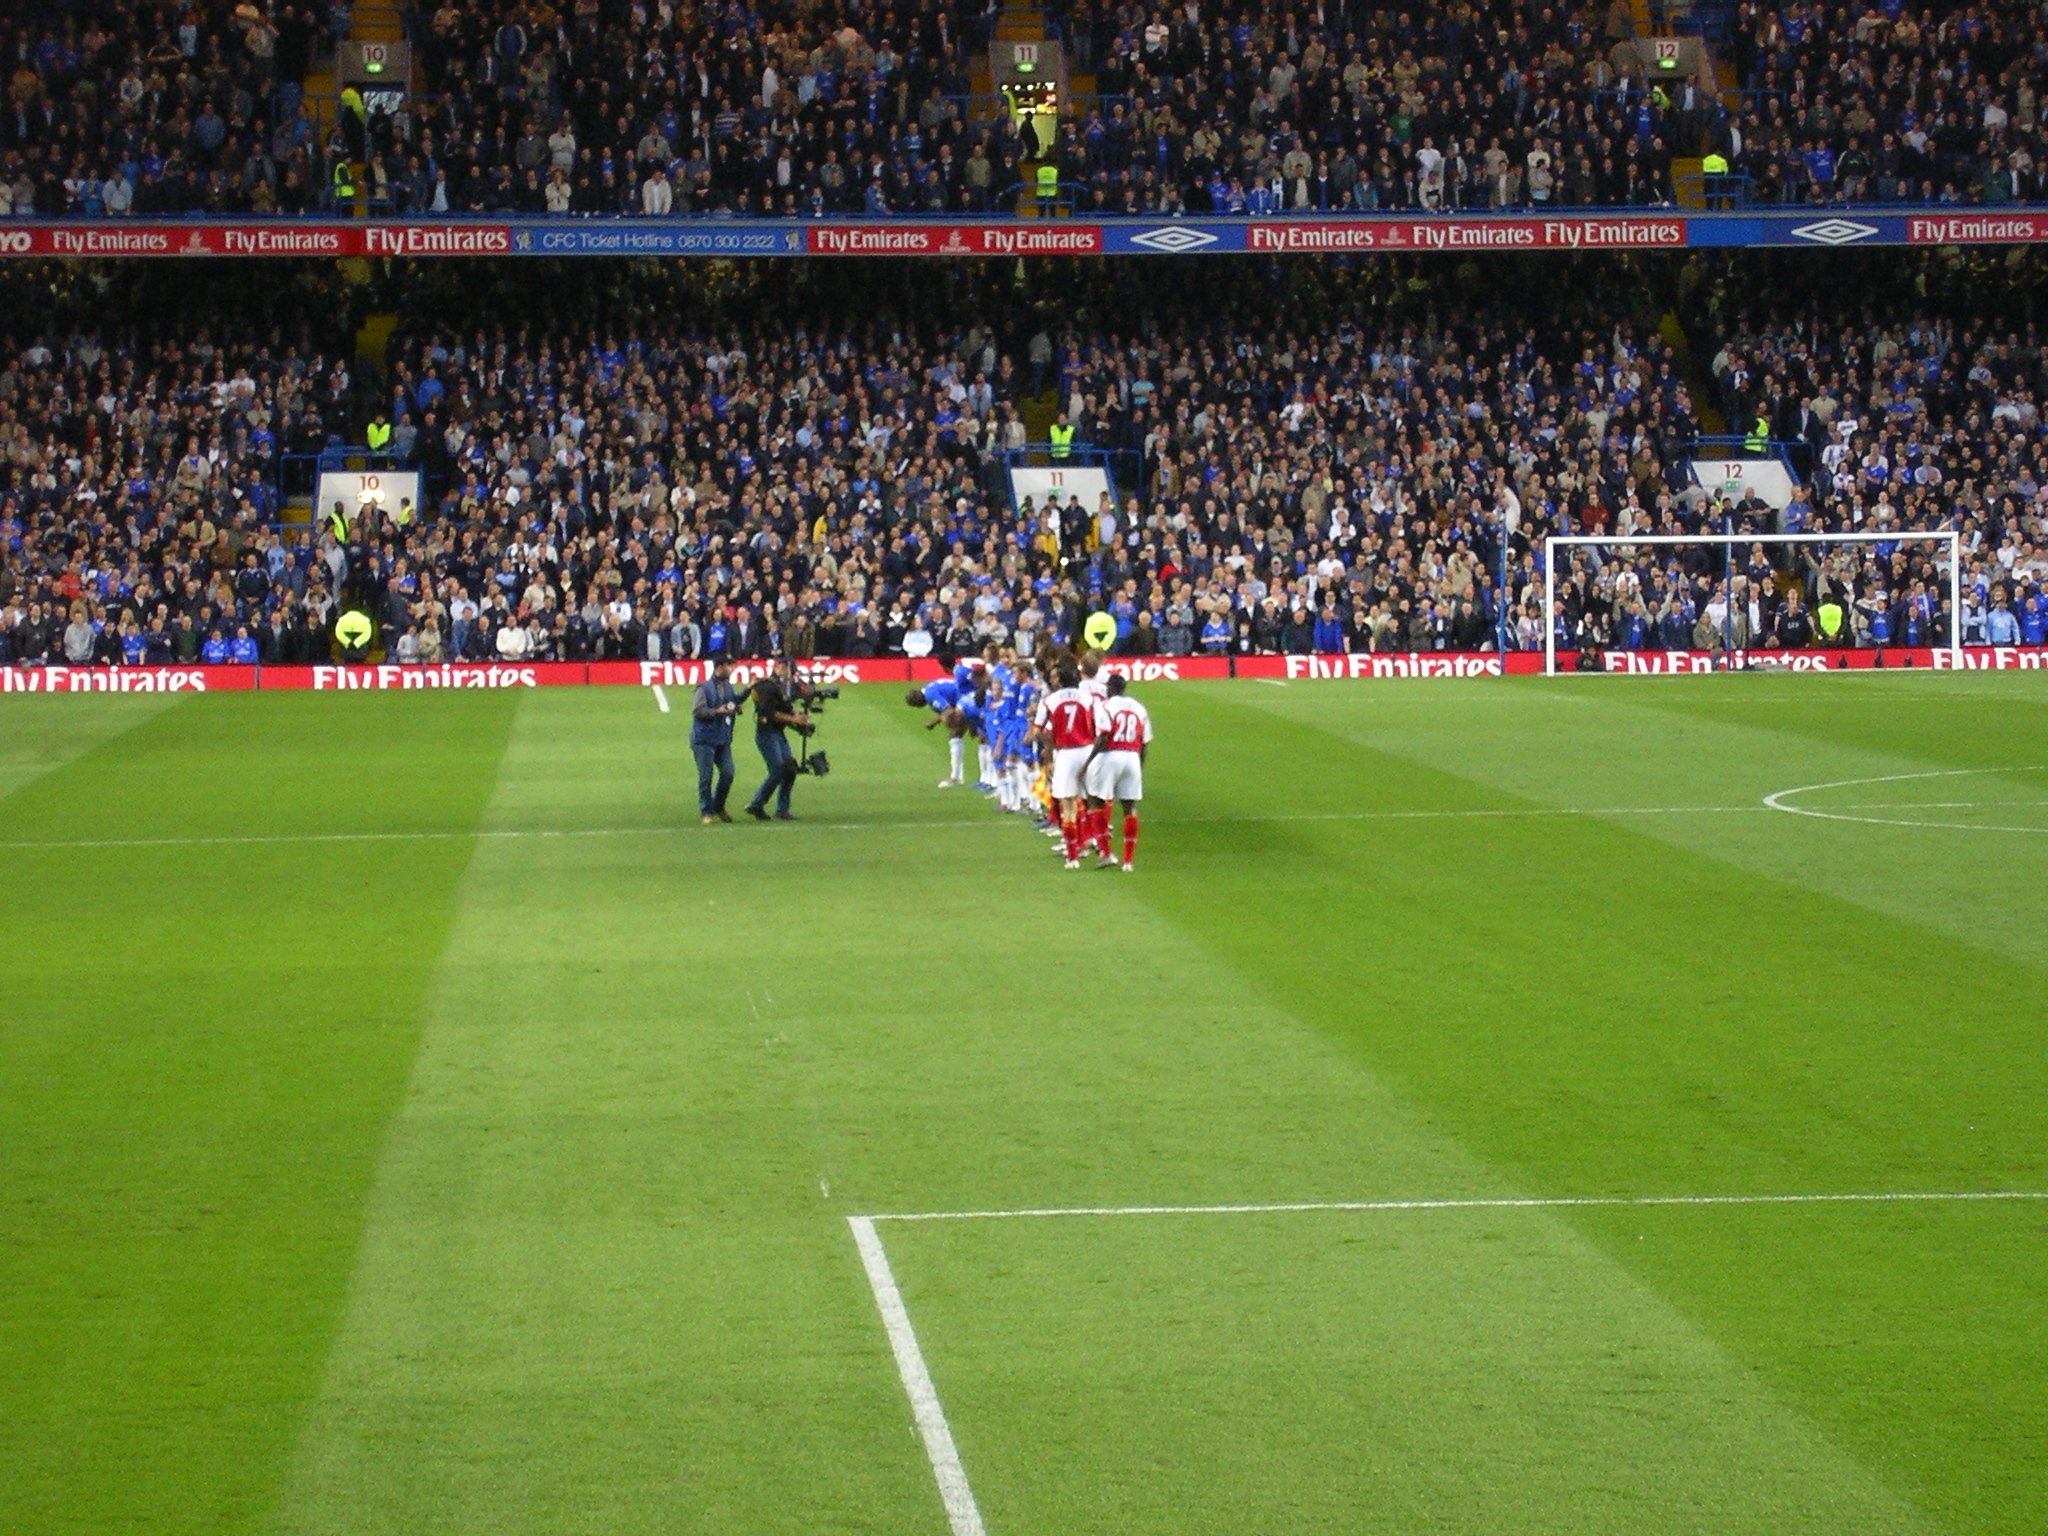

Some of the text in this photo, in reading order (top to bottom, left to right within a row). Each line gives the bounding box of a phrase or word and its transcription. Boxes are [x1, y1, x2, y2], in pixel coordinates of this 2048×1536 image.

[365, 46, 384, 61] 10
[1019, 46, 1032, 61] 11
[1657, 43, 1676, 58] 12
[53, 230, 168, 253] Fly Emirates
[225, 230, 339, 252] Fly Emirates
[365, 228, 507, 254] Fly Emirates
[543, 232, 577, 248] CFC
[580, 232, 620, 248] Ticket
[624, 232, 673, 248] Hotline
[678, 234, 713, 249] 0870
[715, 234, 740, 249] 300
[817, 230, 928, 252] Fly Emirates
[984, 229, 1095, 252] Fly Emirates
[1253, 227, 1374, 250] Fly Emirates
[1413, 225, 1535, 248] Fly Emirates
[1545, 221, 1680, 248] Fly Emirates
[1913, 220, 2034, 242] Fly Emirates
[360, 474, 380, 490] 10
[1051, 471, 1063, 487] 11
[1724, 463, 1743, 479] 12
[640, 660, 700, 686] Fly
[1285, 652, 1502, 679] Fly Emirates
[1603, 651, 1663, 672] Fly
[0, 665, 207, 692] ly Emirates
[311, 663, 538, 690] Fly Emirates
[1063, 703, 1078, 732] 7
[1113, 712, 1138, 743] 28
